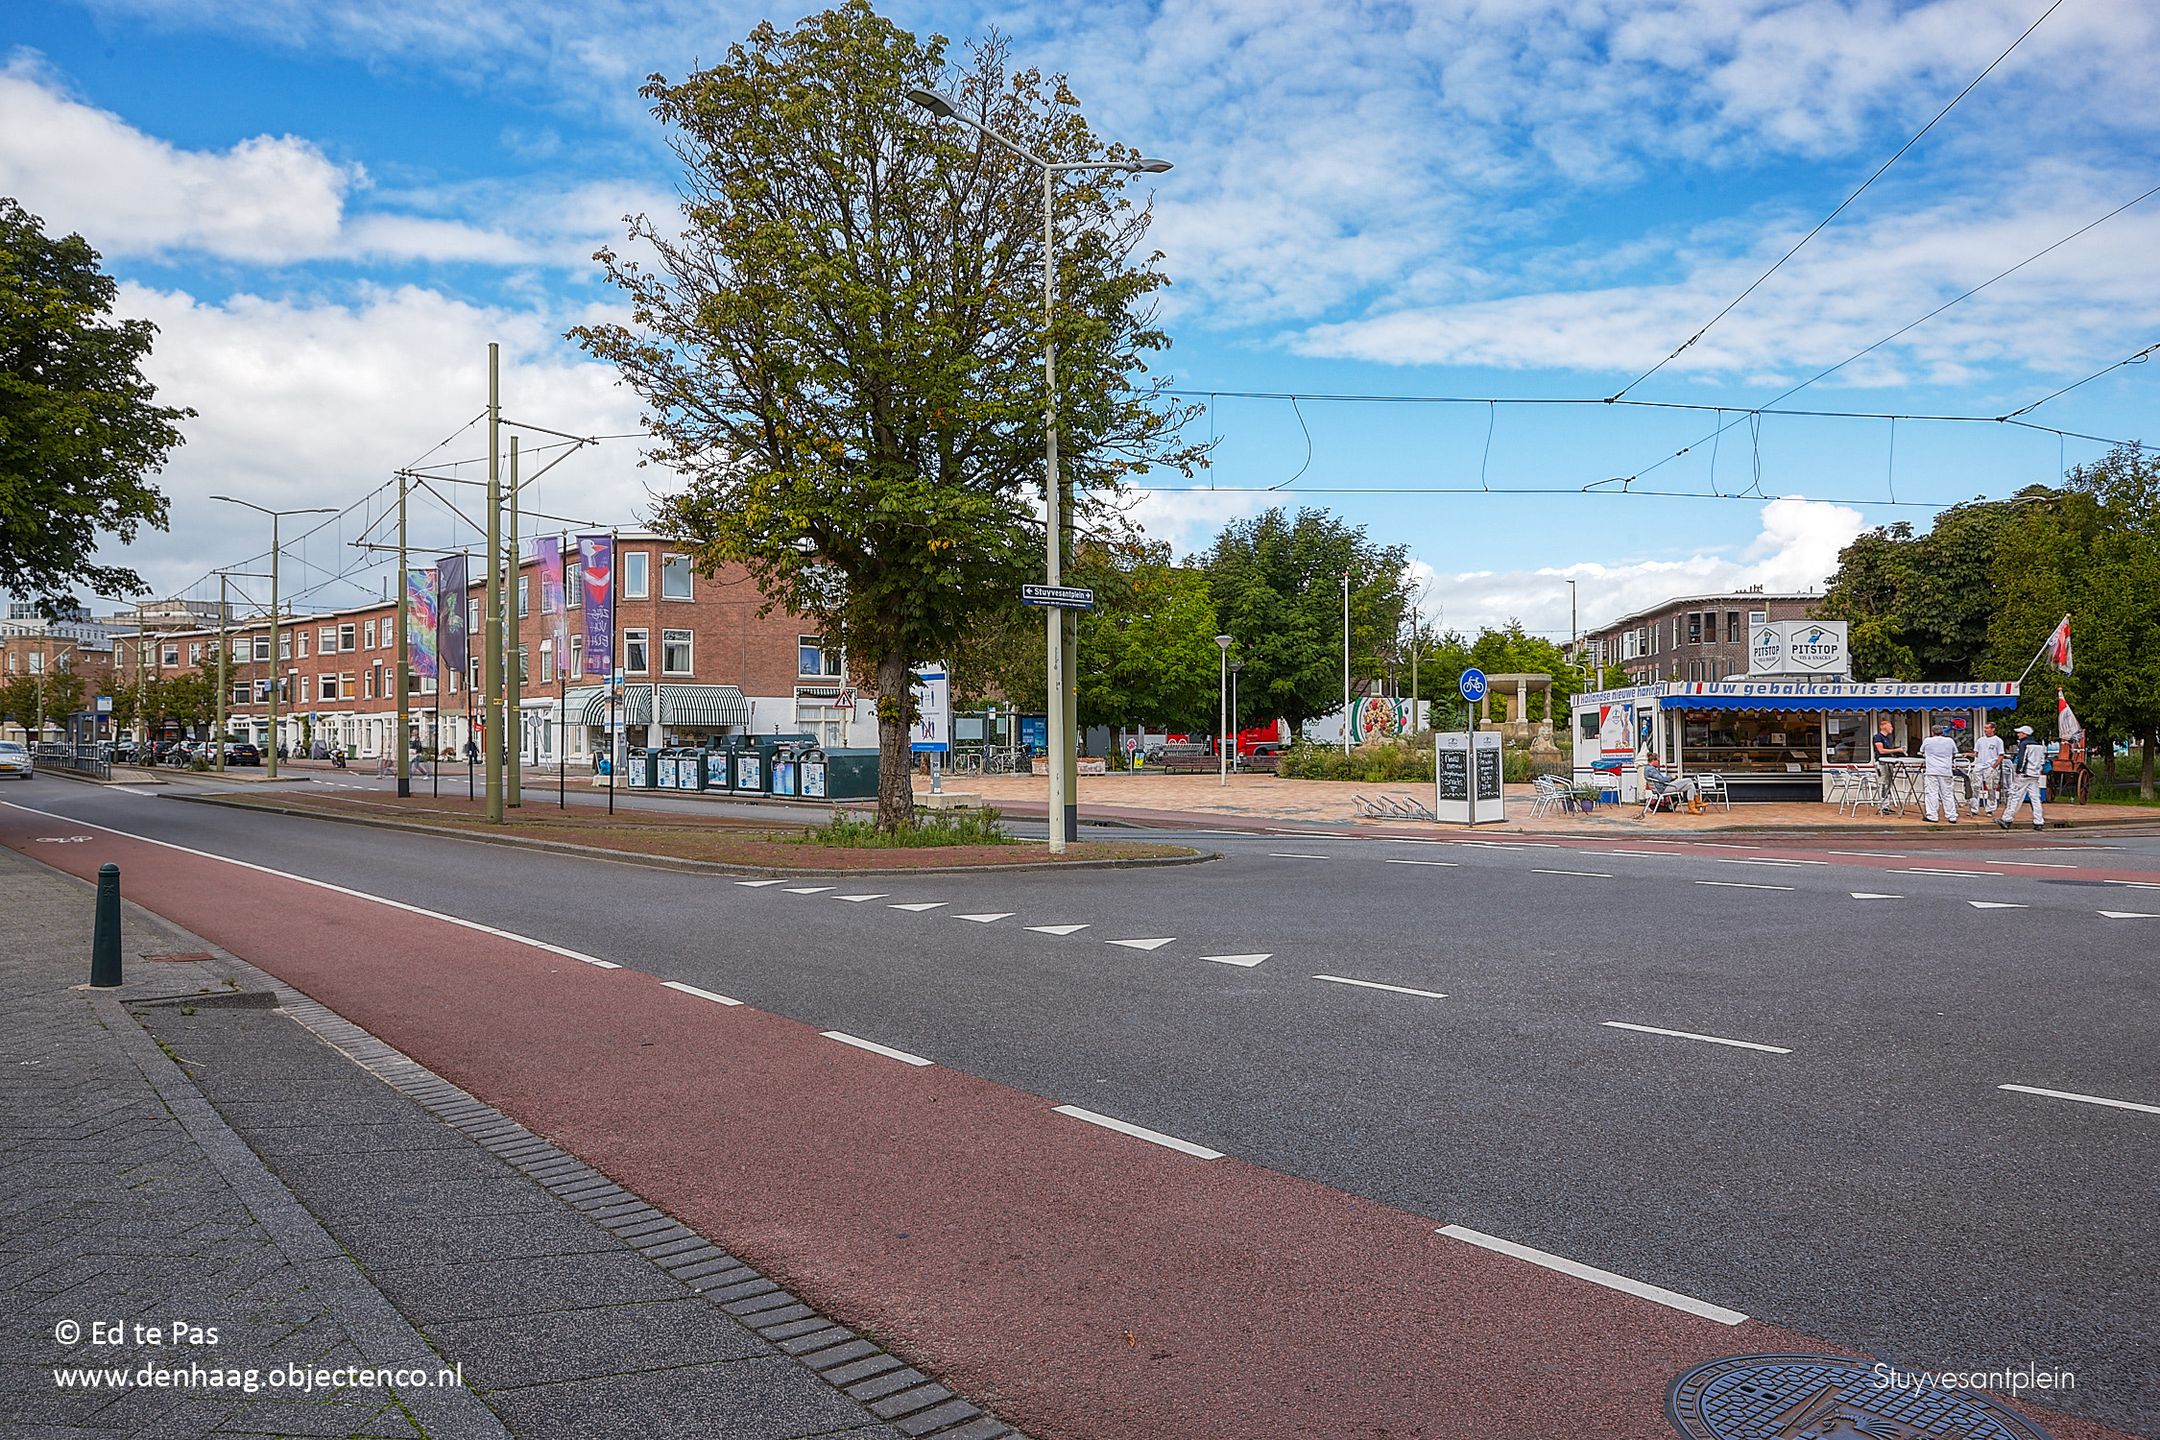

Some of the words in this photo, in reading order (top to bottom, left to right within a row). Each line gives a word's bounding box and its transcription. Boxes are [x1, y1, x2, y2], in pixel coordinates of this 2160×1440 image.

[1034, 588, 1085, 599] Stuyvesantplein
[1754, 645, 1780, 656] PITSTOP
[1792, 645, 1838, 654] PITSTOP
[1708, 682, 1737, 694] Uw
[1744, 682, 1842, 696] gebakken
[1849, 682, 1878, 694] vis
[1884, 682, 1989, 696] specialist
[1581, 692, 1610, 704] Hollandse
[1612, 688, 1635, 699] nieuwe
